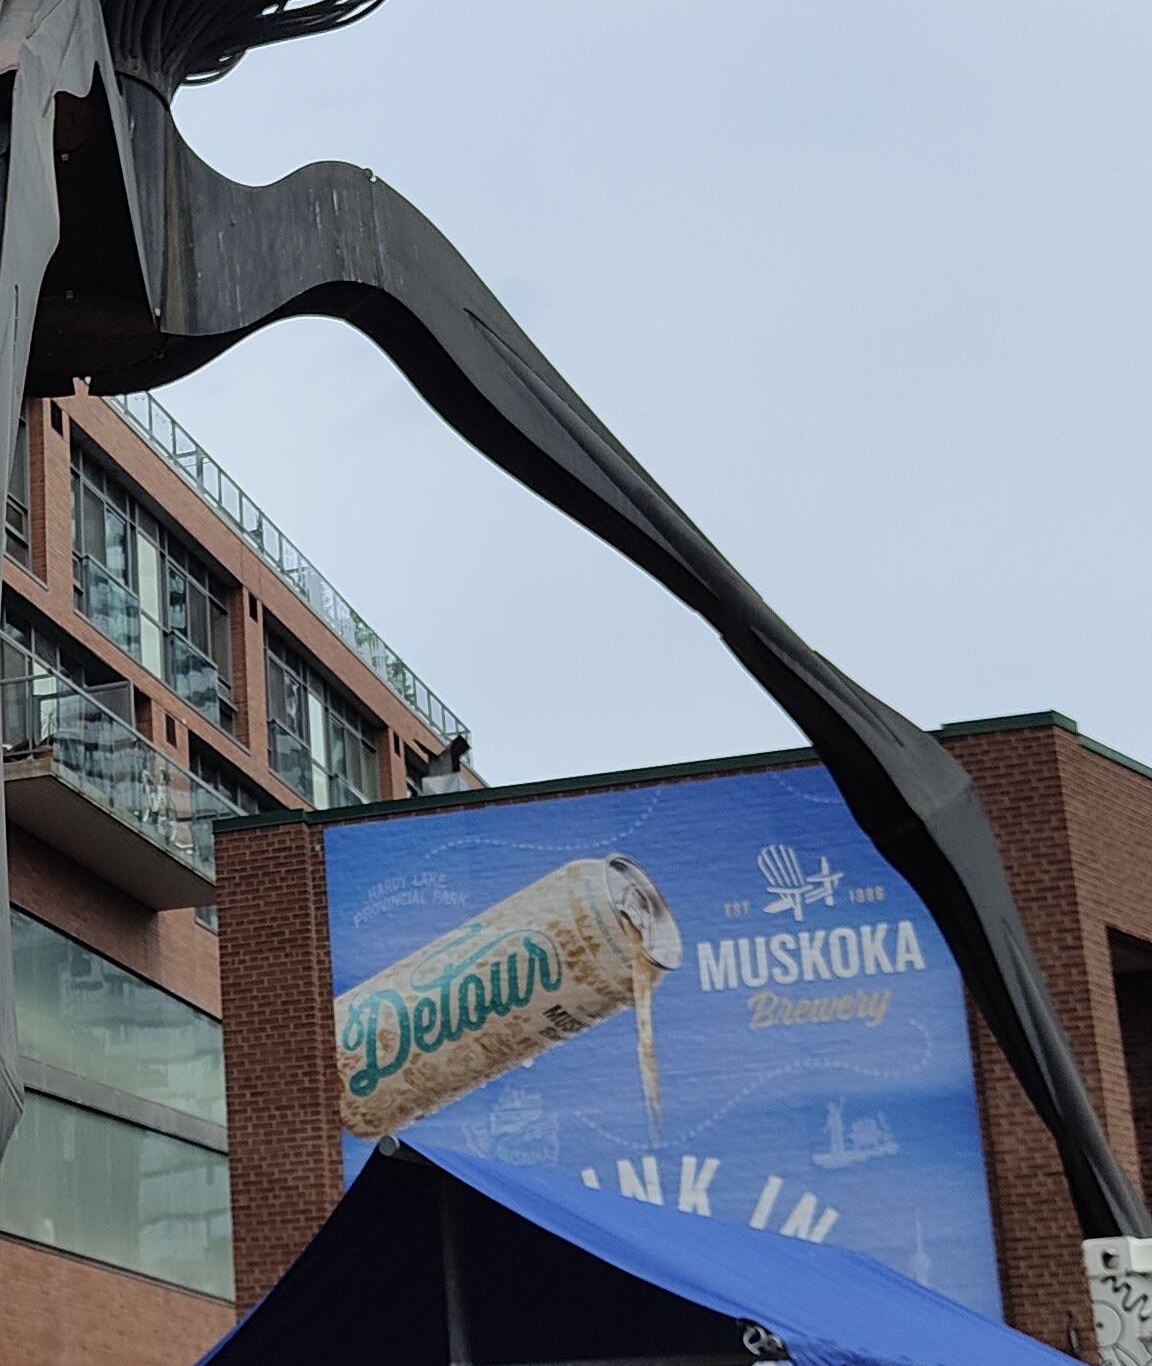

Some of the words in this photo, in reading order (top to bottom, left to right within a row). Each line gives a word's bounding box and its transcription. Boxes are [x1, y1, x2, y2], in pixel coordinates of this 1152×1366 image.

[697, 920, 925, 992] MUSKOKA
[342, 923, 562, 1097] Detour
[748, 989, 889, 1029] Brewery
